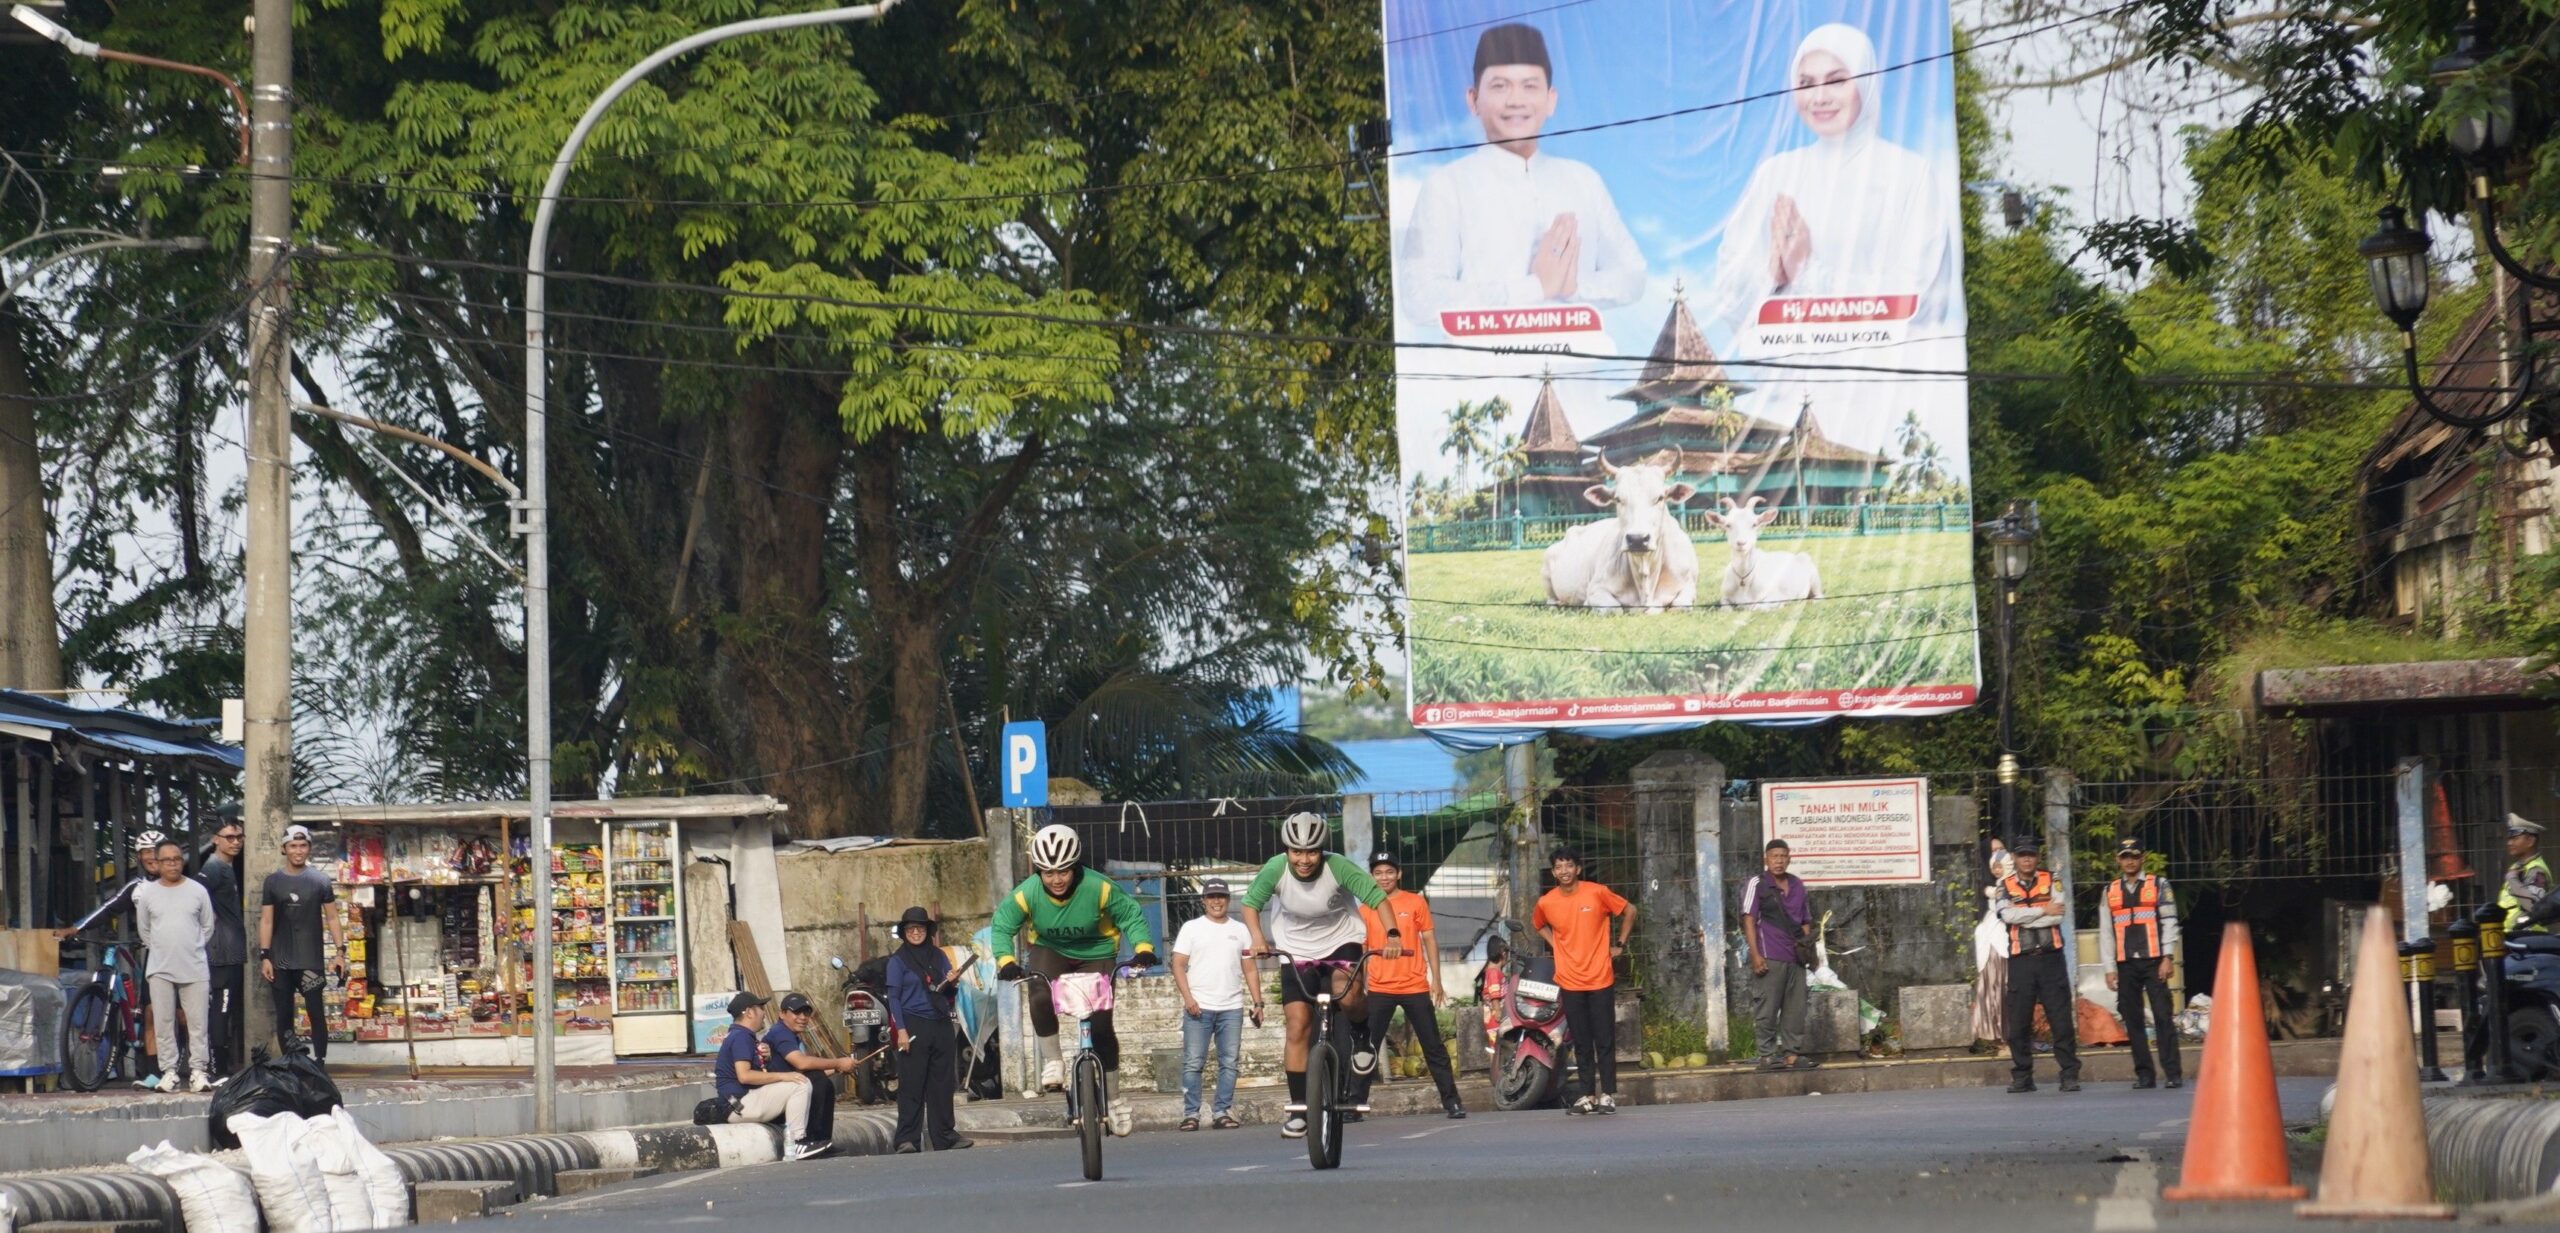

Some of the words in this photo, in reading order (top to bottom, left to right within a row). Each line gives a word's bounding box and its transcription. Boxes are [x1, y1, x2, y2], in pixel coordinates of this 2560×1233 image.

[1782, 302, 1805, 320] Hj.
[1810, 300, 1888, 316] ANANDA
[1457, 315, 1475, 331] H.
[1479, 313, 1499, 329] M.
[1502, 311, 1561, 329] YAMIN
[1565, 310, 1591, 326] HR
[1760, 334, 1806, 345] WAKIL
[1813, 332, 1848, 344] WALI
[1852, 331, 1891, 342] KOTA
[1581, 701, 1676, 716] pemkobanjarmasin
[1702, 698, 1731, 710] Media
[1733, 698, 1766, 709] Center
[1767, 695, 1829, 709] Banjarmasin
[1459, 706, 1559, 721] pemko_banjarmasin
[1010, 735, 1037, 794] P
[1800, 803, 1835, 814] TANAH
[1840, 803, 1854, 813] INI
[1858, 801, 1888, 812] MILIK
[1780, 816, 1789, 825] PT
[1791, 814, 1832, 825] PELABUHAN
[1834, 813, 1872, 824] INDONESIA
[1874, 812, 1913, 824] (PERSERO)
[1047, 926, 1085, 937] MAN
